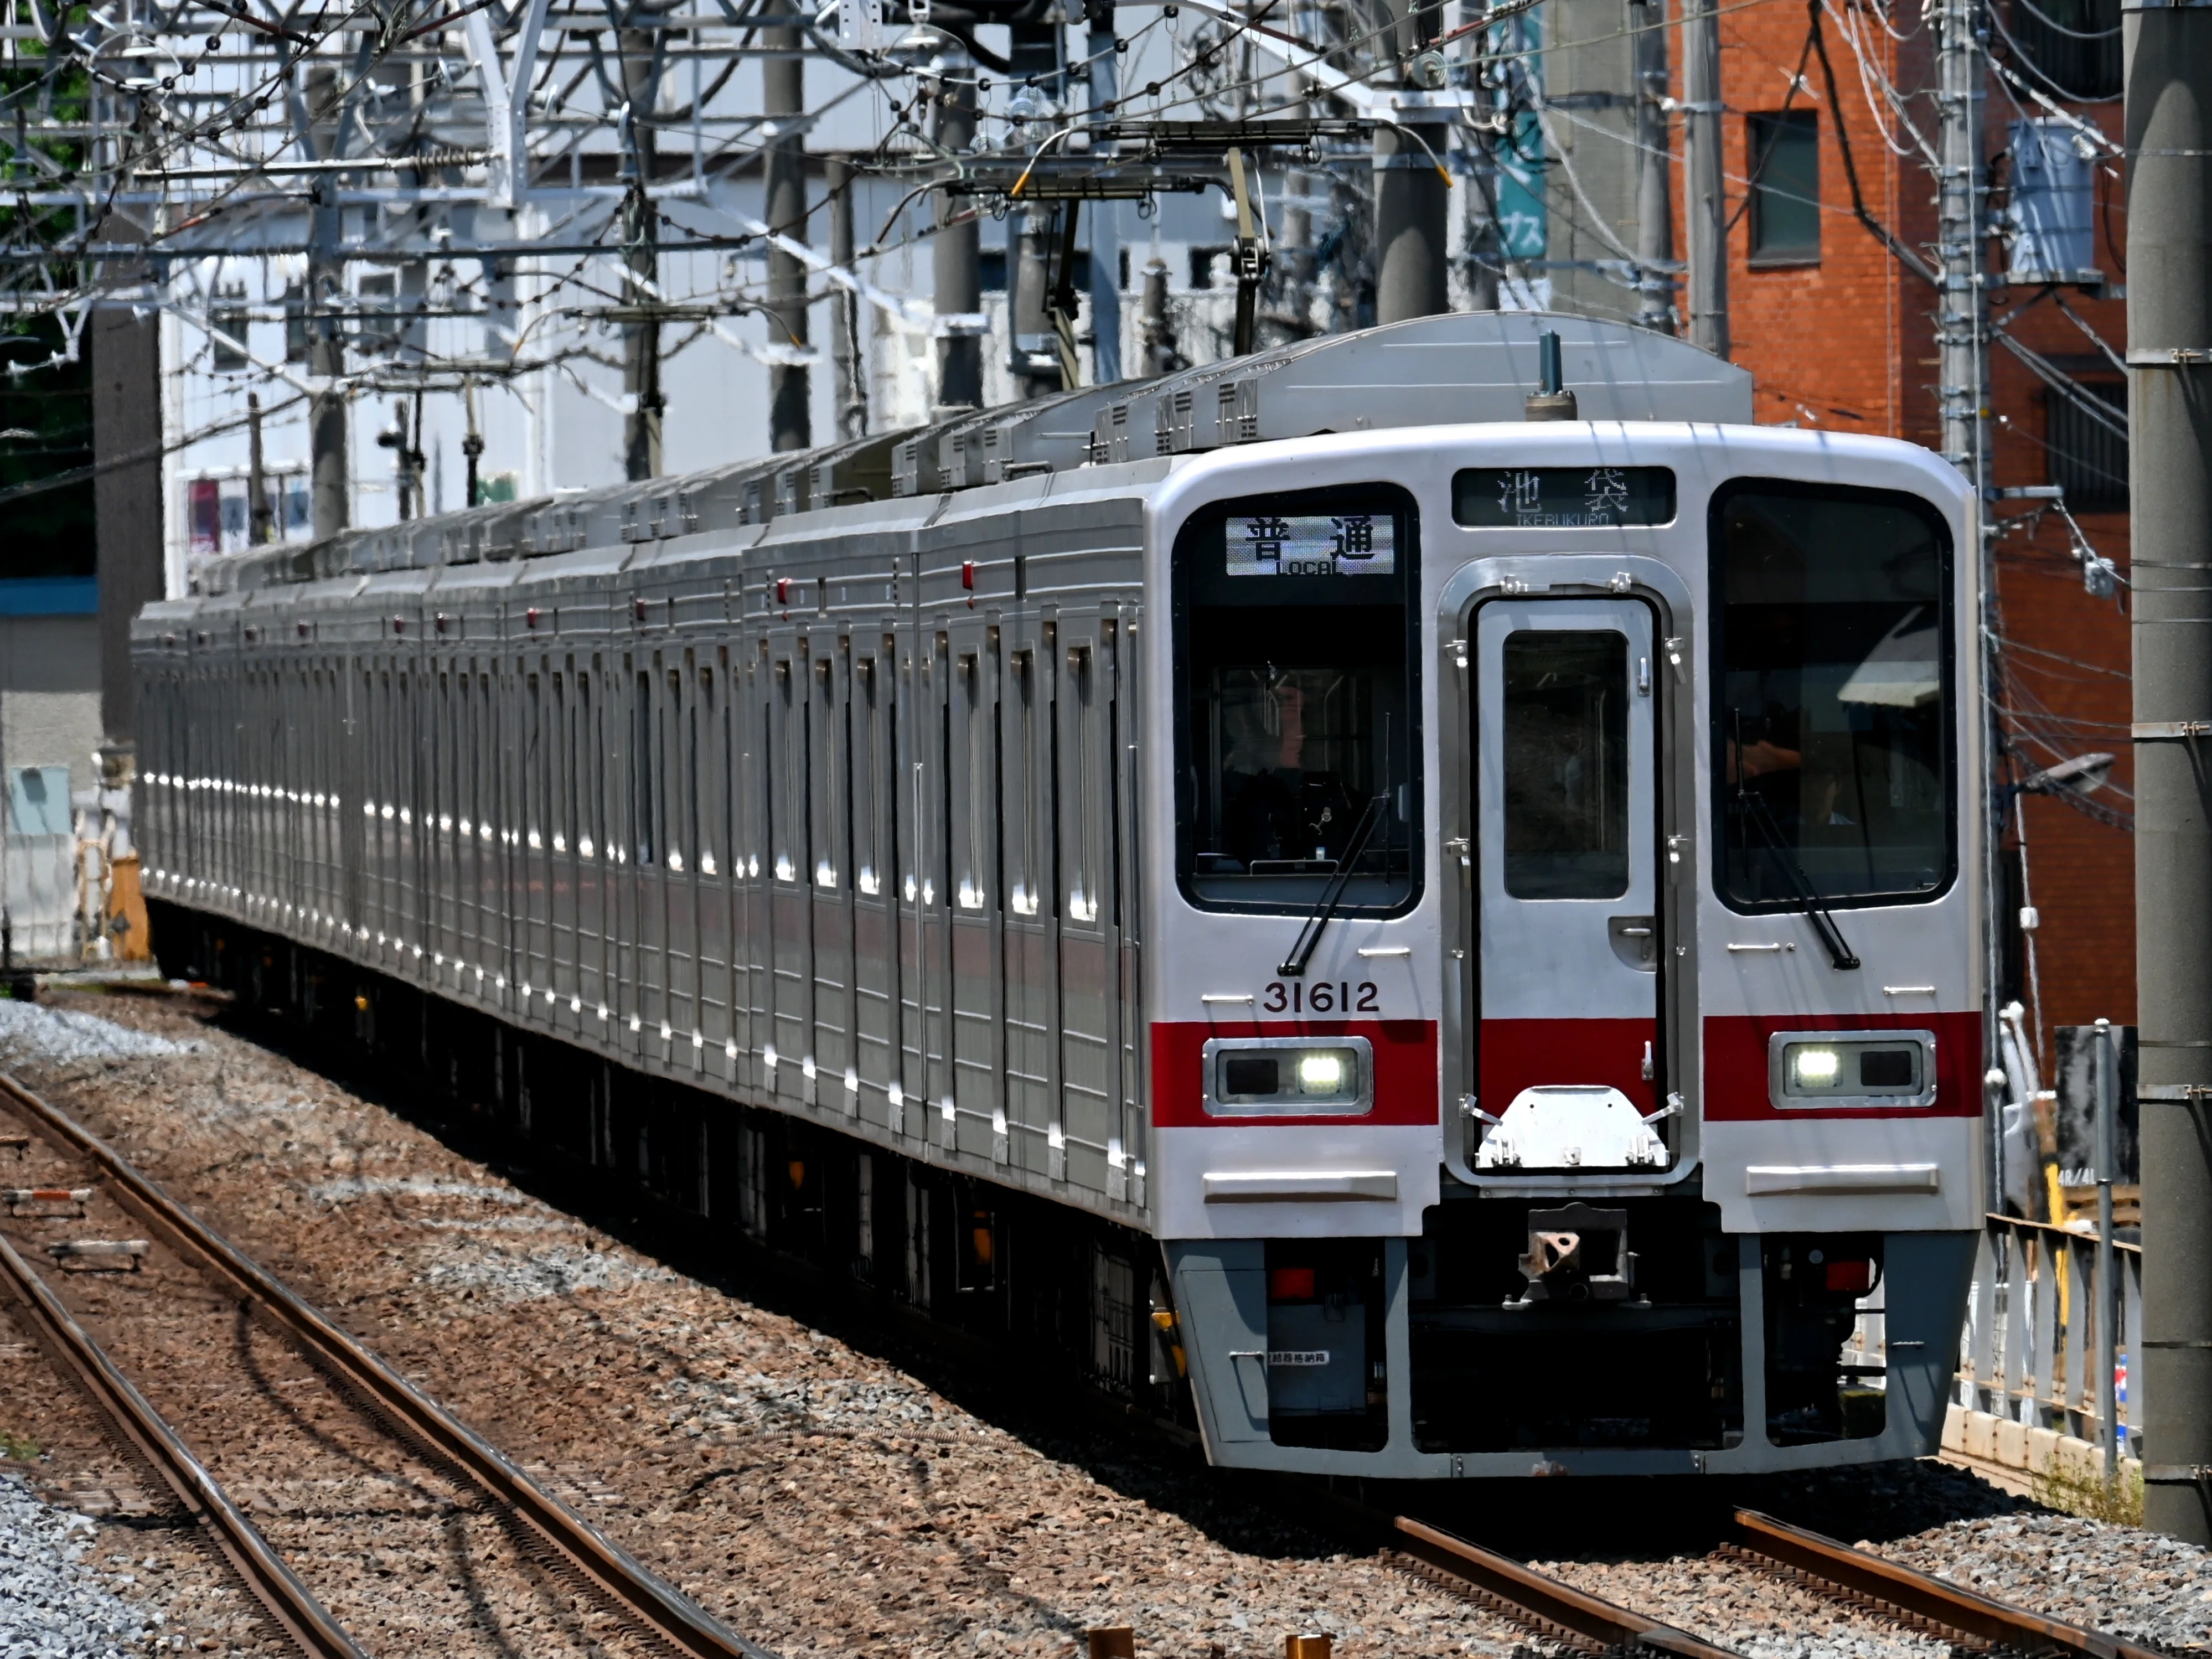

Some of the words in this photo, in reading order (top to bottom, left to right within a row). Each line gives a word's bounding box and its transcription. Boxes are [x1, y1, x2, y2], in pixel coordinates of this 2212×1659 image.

[1497, 468, 1629, 513] 池袋
[1245, 516, 1376, 561] 普通
[1263, 981, 1379, 1012] 31612
